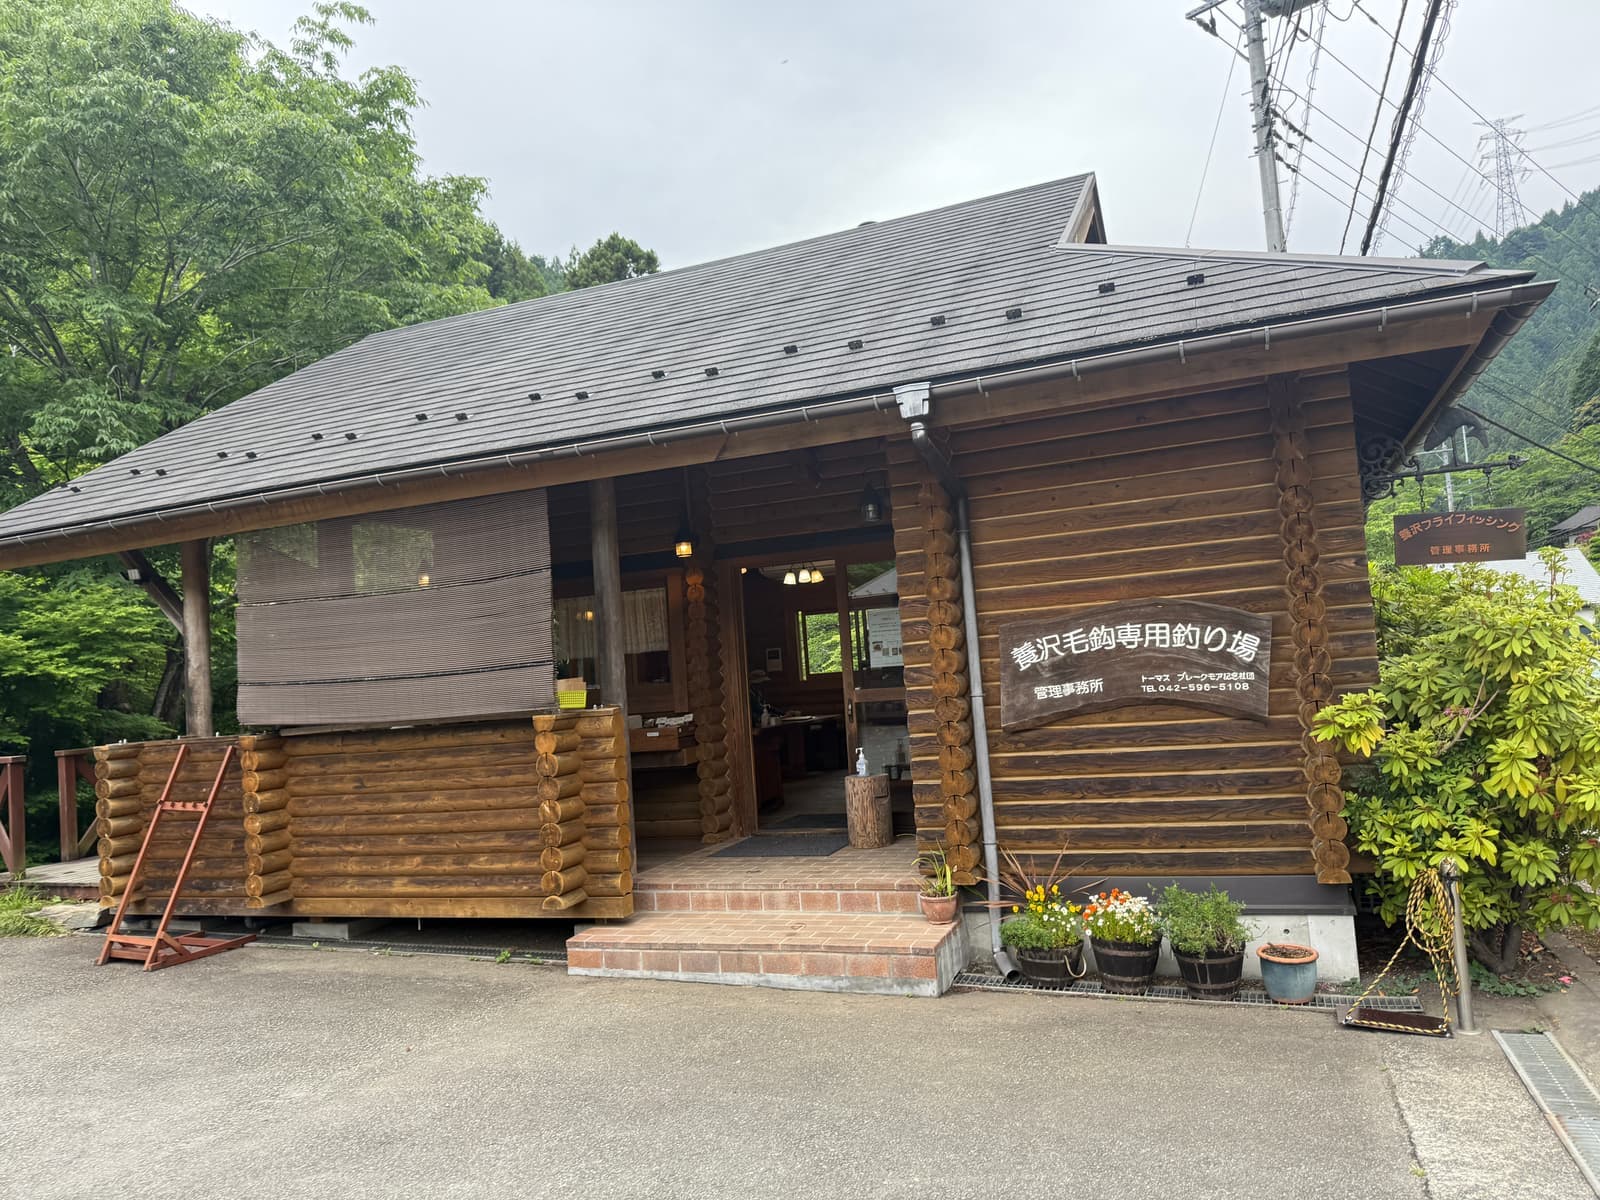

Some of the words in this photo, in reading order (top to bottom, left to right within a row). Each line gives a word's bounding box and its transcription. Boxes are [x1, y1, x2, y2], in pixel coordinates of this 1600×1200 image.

[1430, 543, 1490, 556] 管理事務所
[1141, 674, 1170, 683] トーマス
[1034, 678, 1104, 700] 管理事務所
